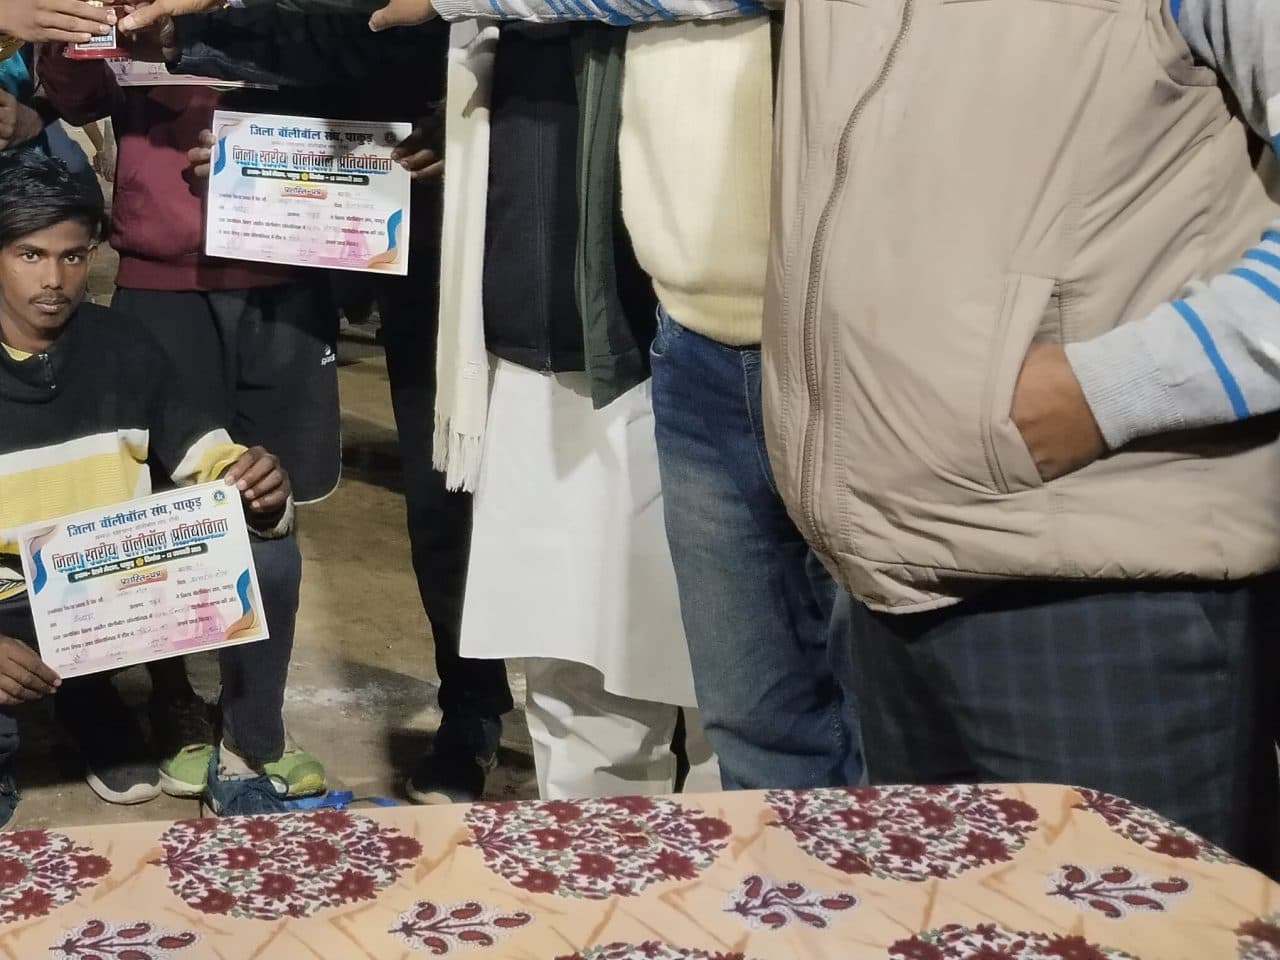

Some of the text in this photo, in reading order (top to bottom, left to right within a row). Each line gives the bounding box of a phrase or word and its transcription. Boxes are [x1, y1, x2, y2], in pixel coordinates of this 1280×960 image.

[250, 124, 274, 137] जिला
[232, 147, 255, 162] जिला
[259, 148, 288, 165] स्तरीय
[337, 153, 393, 171] प्रतियोगिता
[67, 522, 95, 538] जिला
[100, 510, 147, 529] वॉलीबॉल
[152, 504, 172, 518] संघ,
[52, 552, 81, 571] जिला
[84, 541, 117, 562] स्तरीय
[171, 518, 229, 543] प्रतियोगिता
